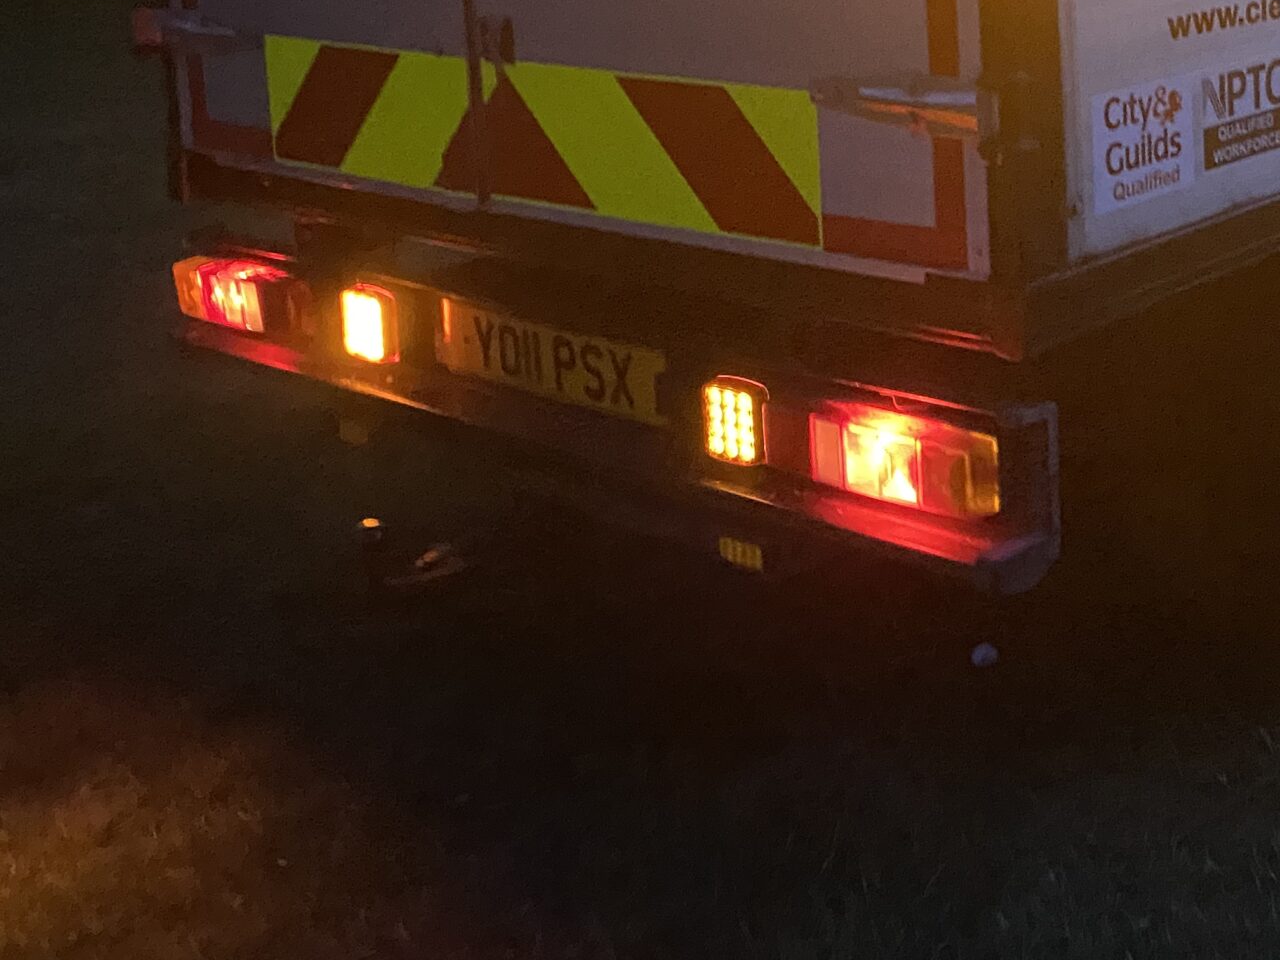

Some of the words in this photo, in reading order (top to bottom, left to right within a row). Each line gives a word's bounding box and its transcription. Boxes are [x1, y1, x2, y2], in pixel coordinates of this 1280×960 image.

[1217, 112, 1275, 142] QUALIFIED
[1105, 128, 1182, 176] Guilds
[1113, 164, 1180, 201] Qualified
[552, 334, 634, 410] PSX
